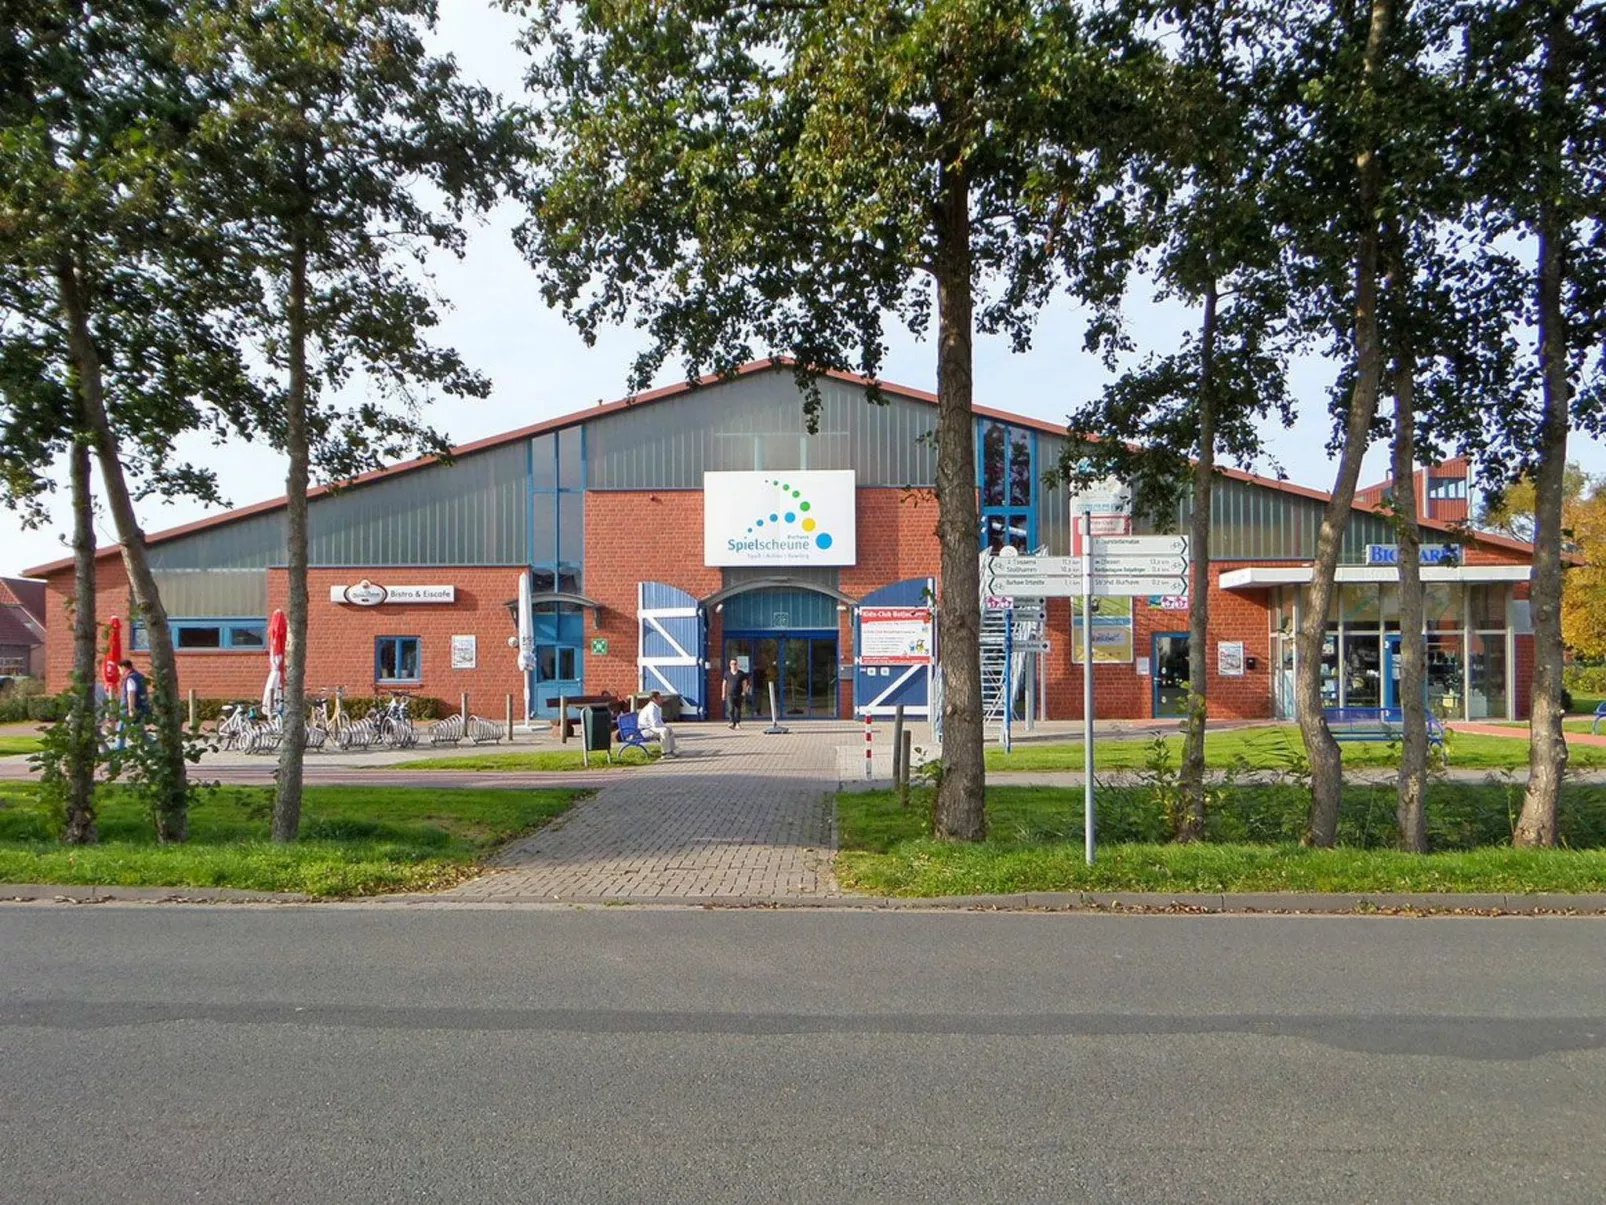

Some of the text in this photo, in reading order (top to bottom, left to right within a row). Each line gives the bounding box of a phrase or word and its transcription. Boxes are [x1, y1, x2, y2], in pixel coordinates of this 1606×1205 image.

[727, 537, 810, 553] Spielscheune
[390, 589, 413, 598] Bistro
[415, 590, 421, 598] &
